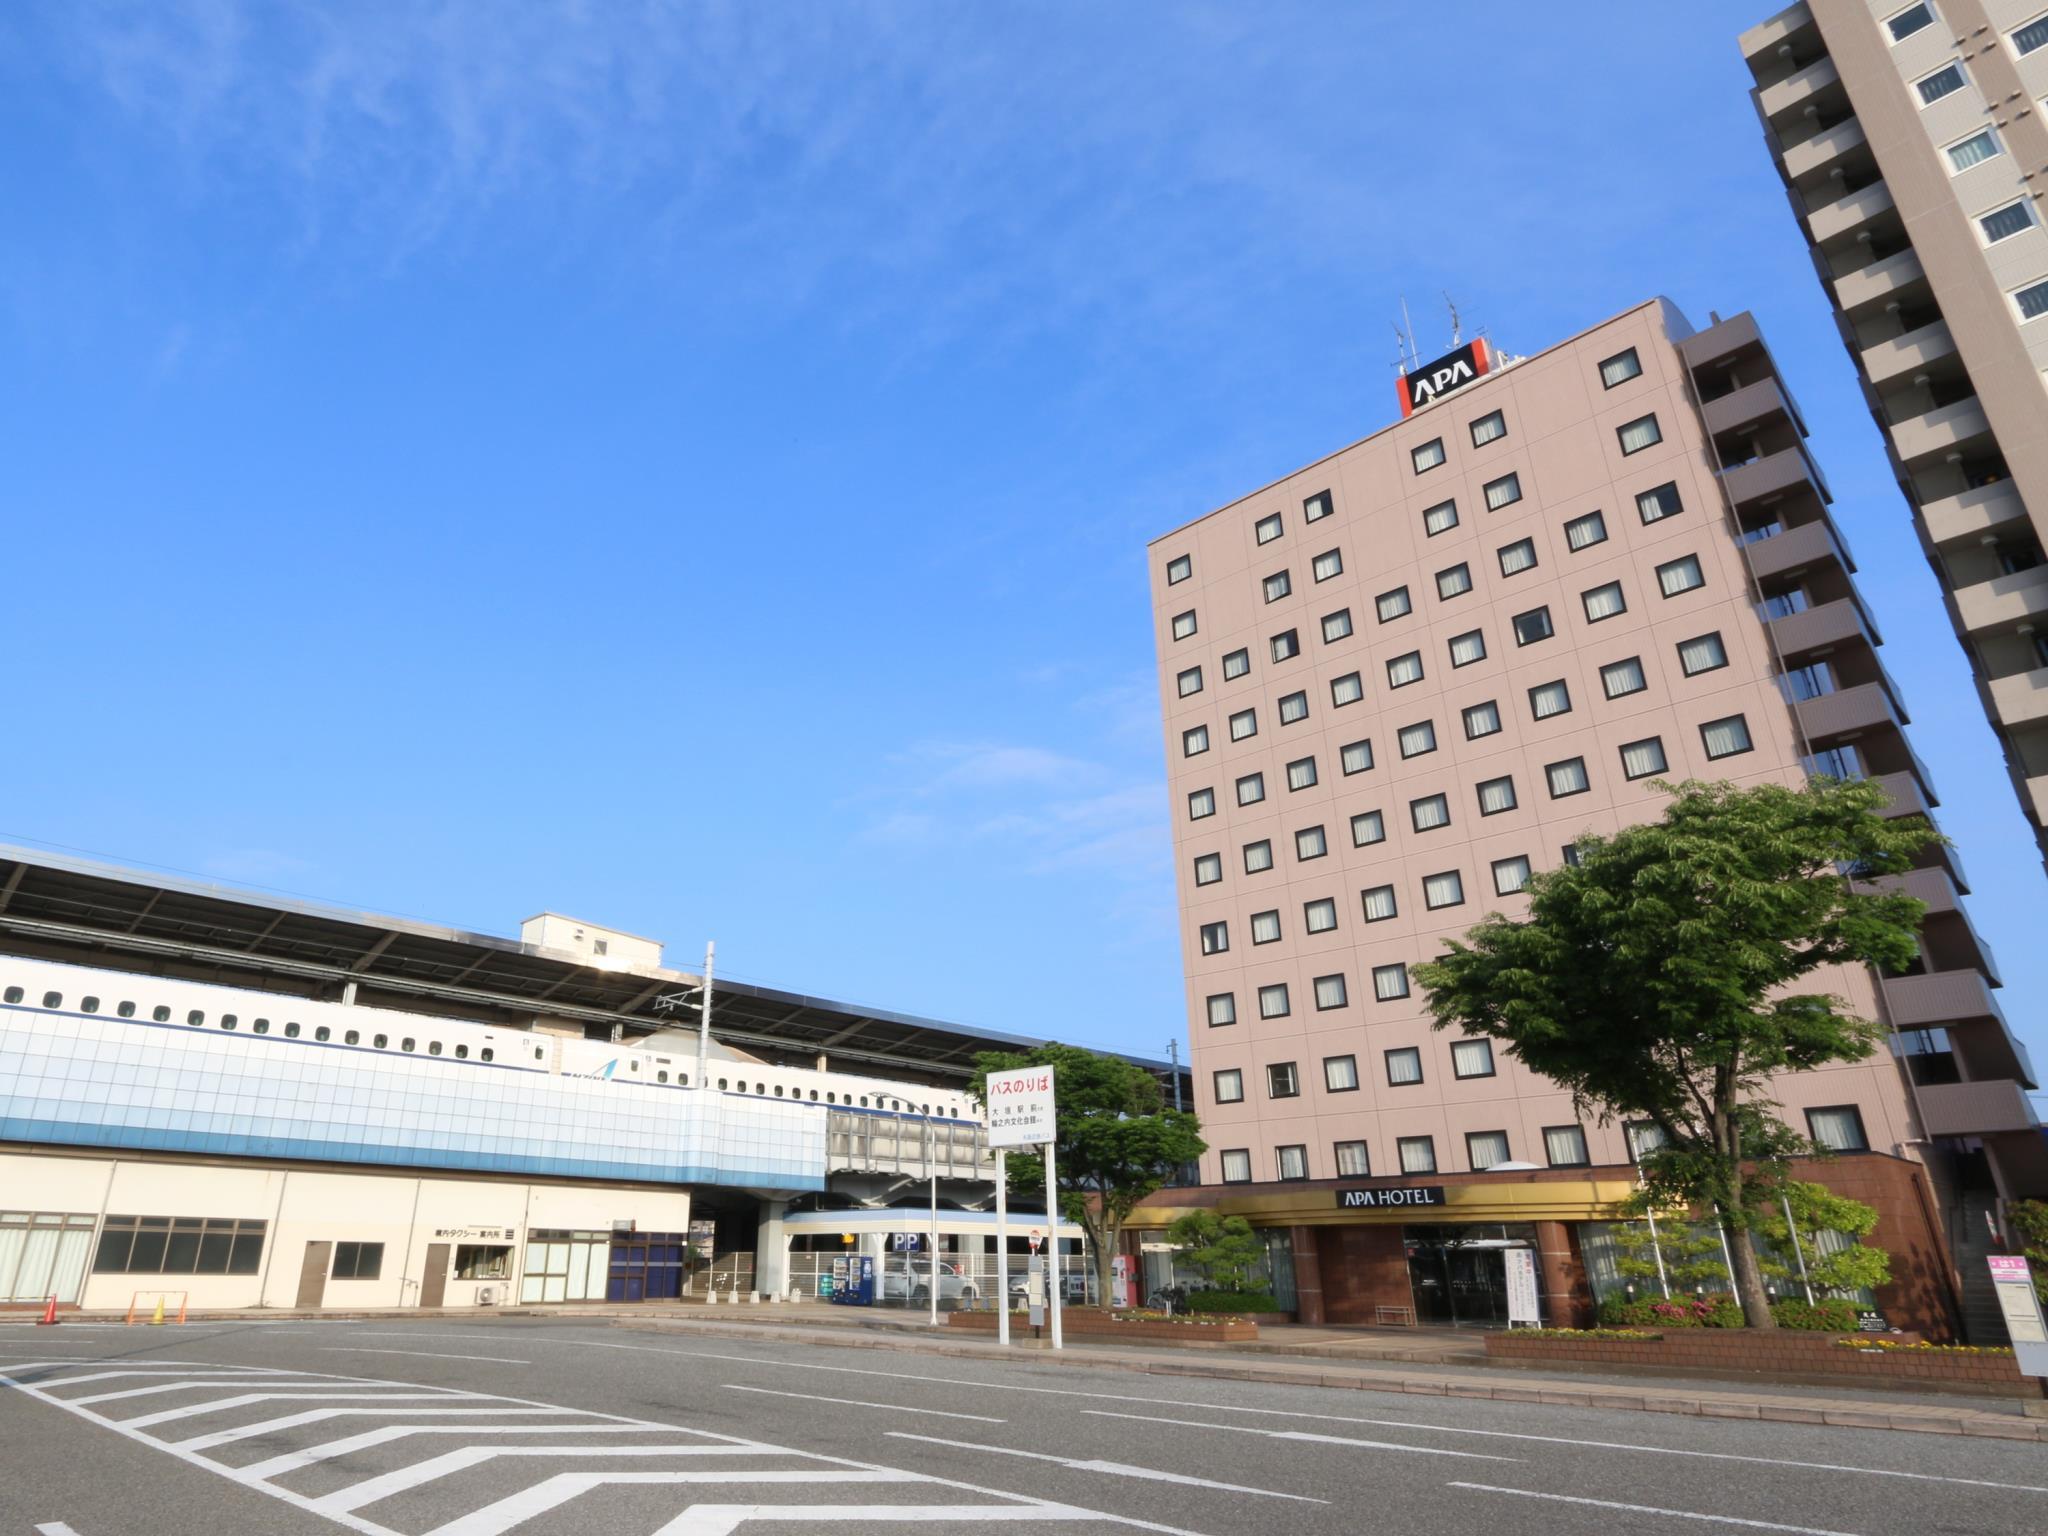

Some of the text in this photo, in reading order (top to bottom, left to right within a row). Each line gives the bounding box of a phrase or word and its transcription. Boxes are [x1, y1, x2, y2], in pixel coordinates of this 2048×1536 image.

[1414, 359, 1474, 403] APA
[991, 1075, 1049, 1096] バスのりば
[1345, 1189, 1434, 1206] APA HOTEL
